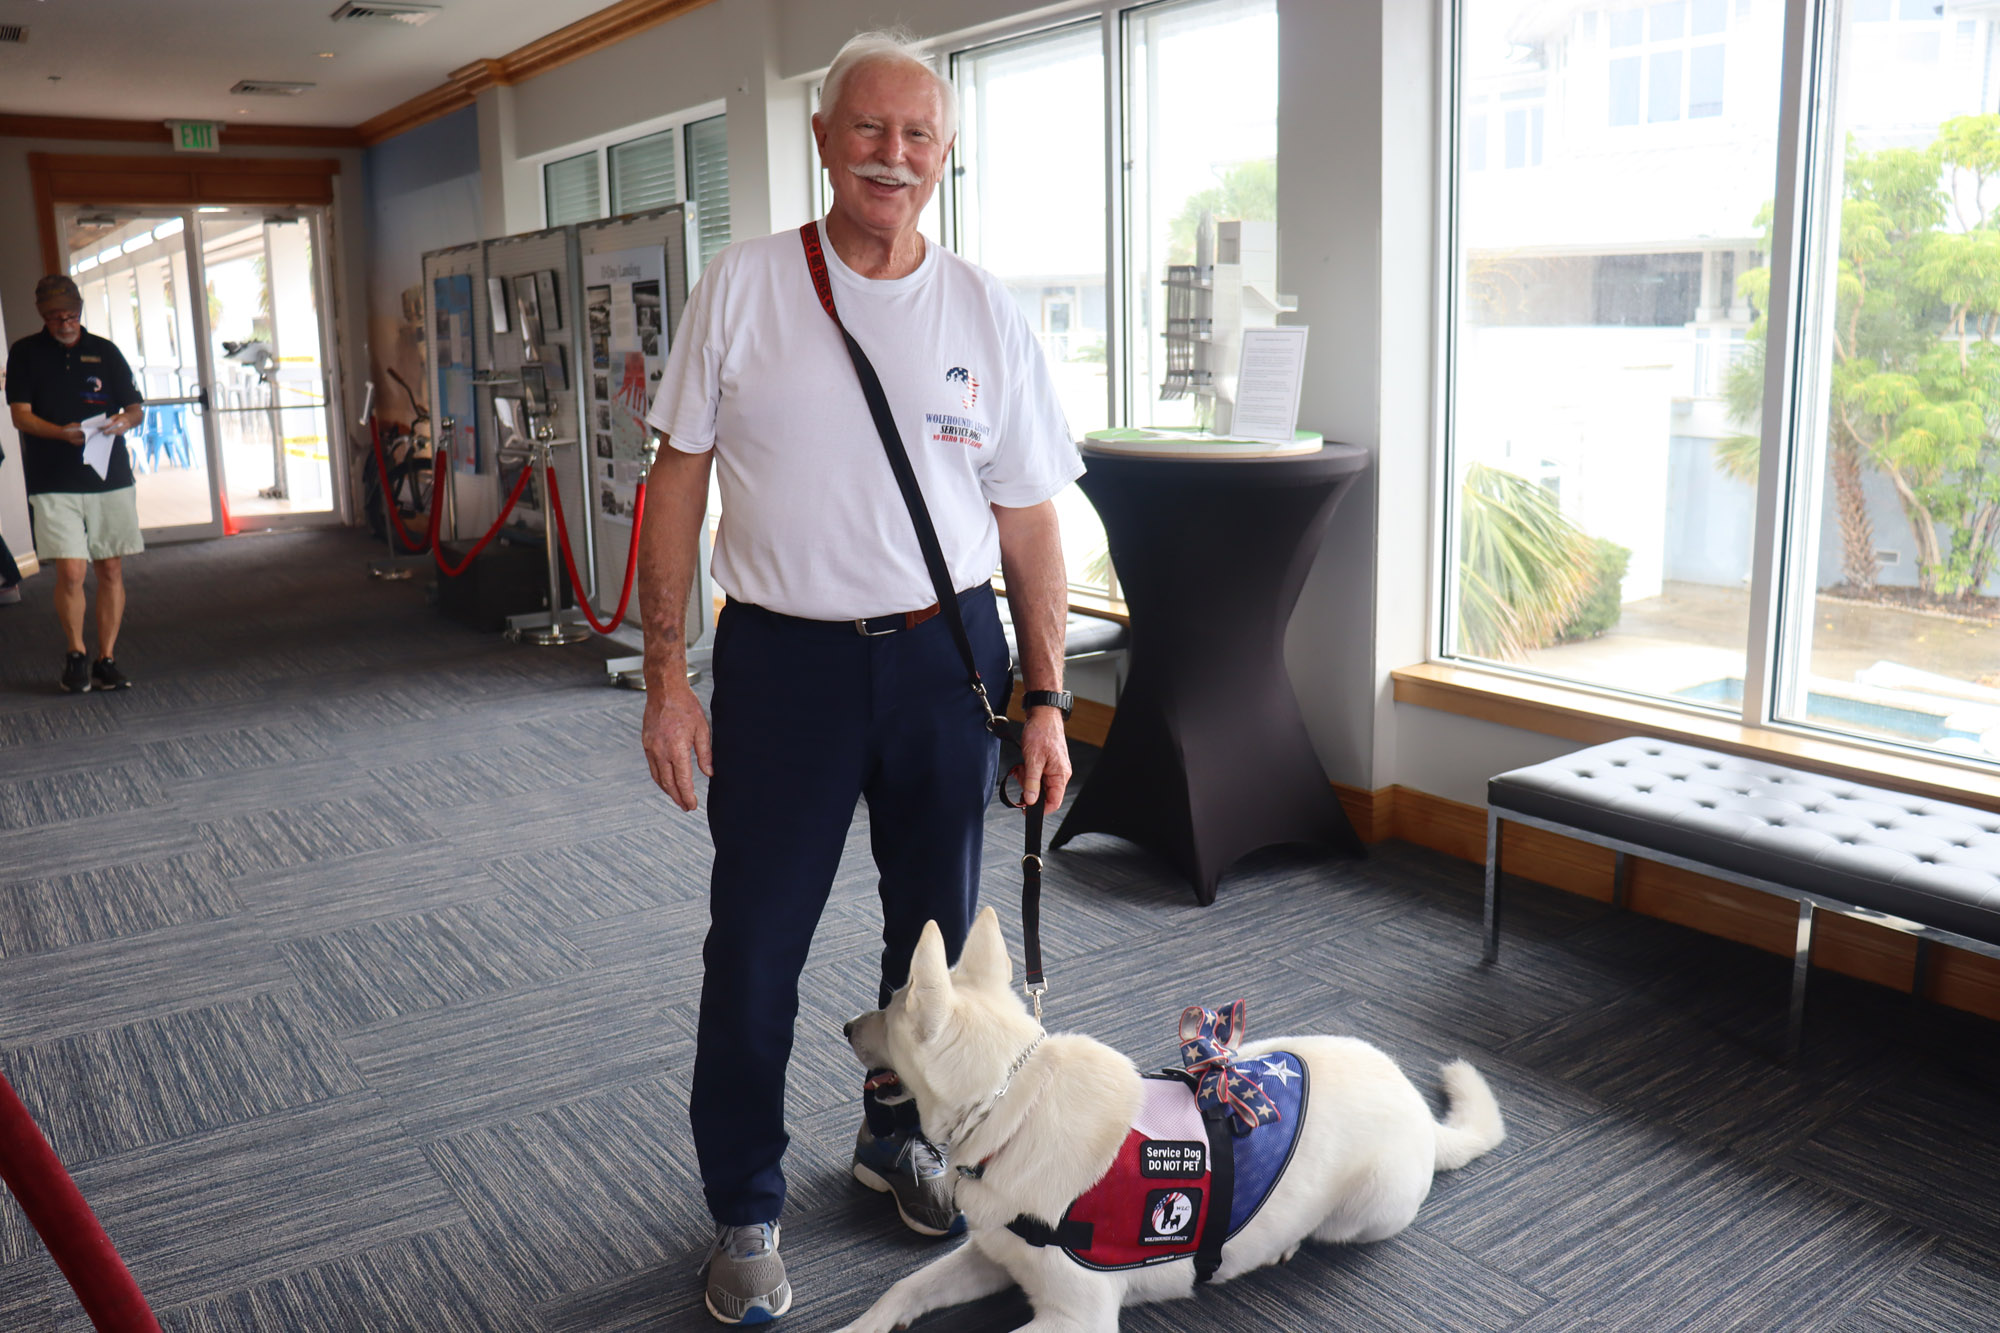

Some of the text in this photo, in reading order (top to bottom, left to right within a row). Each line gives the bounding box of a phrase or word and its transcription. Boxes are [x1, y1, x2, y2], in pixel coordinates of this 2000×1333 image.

[181, 125, 212, 148] EXIT
[940, 425, 969, 437] SERVICE
[1146, 1146, 1201, 1160] Service Dog
[1149, 1160, 1200, 1172] DO NOT PET
